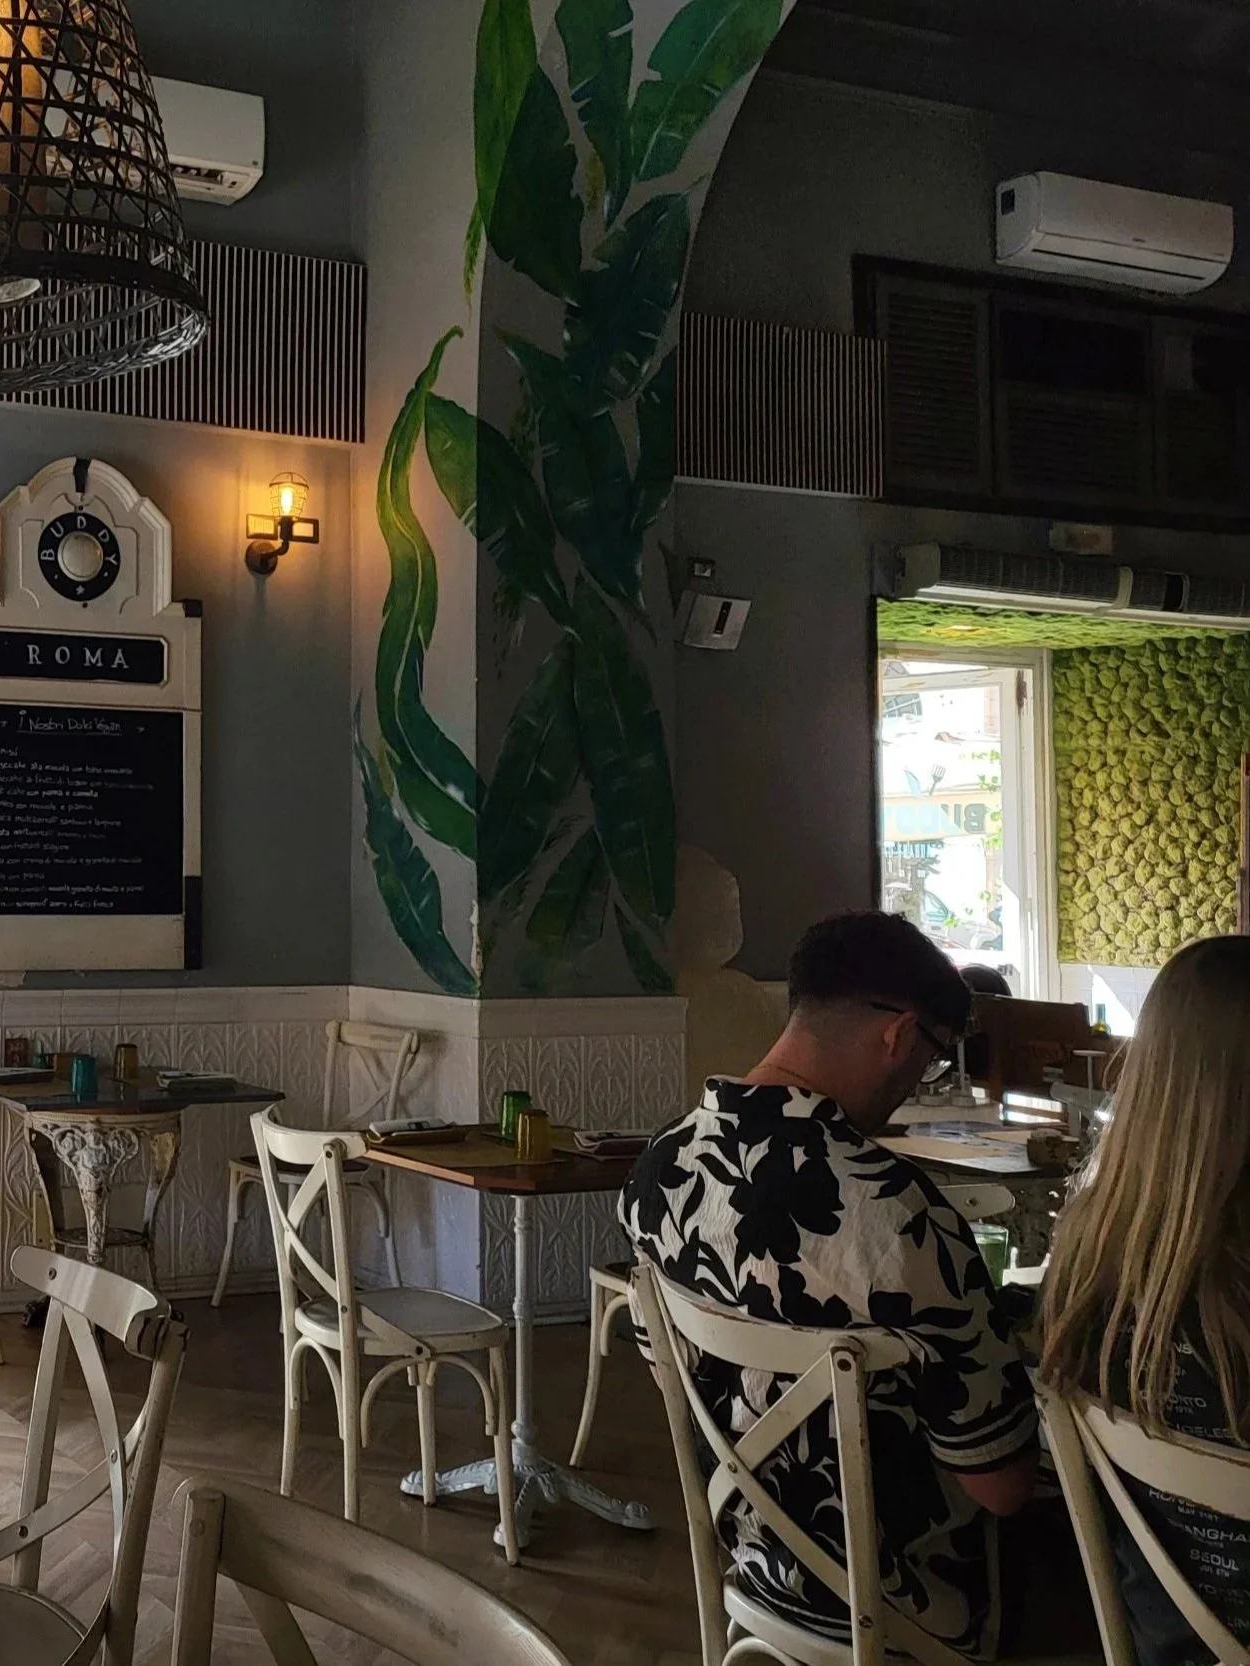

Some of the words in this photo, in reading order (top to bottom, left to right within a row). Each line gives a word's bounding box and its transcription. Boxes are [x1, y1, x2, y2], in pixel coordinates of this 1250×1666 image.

[40, 515, 119, 567] BUDDY
[26, 643, 130, 669] ROMA
[1190, 1548, 1240, 1573] SEOUL
